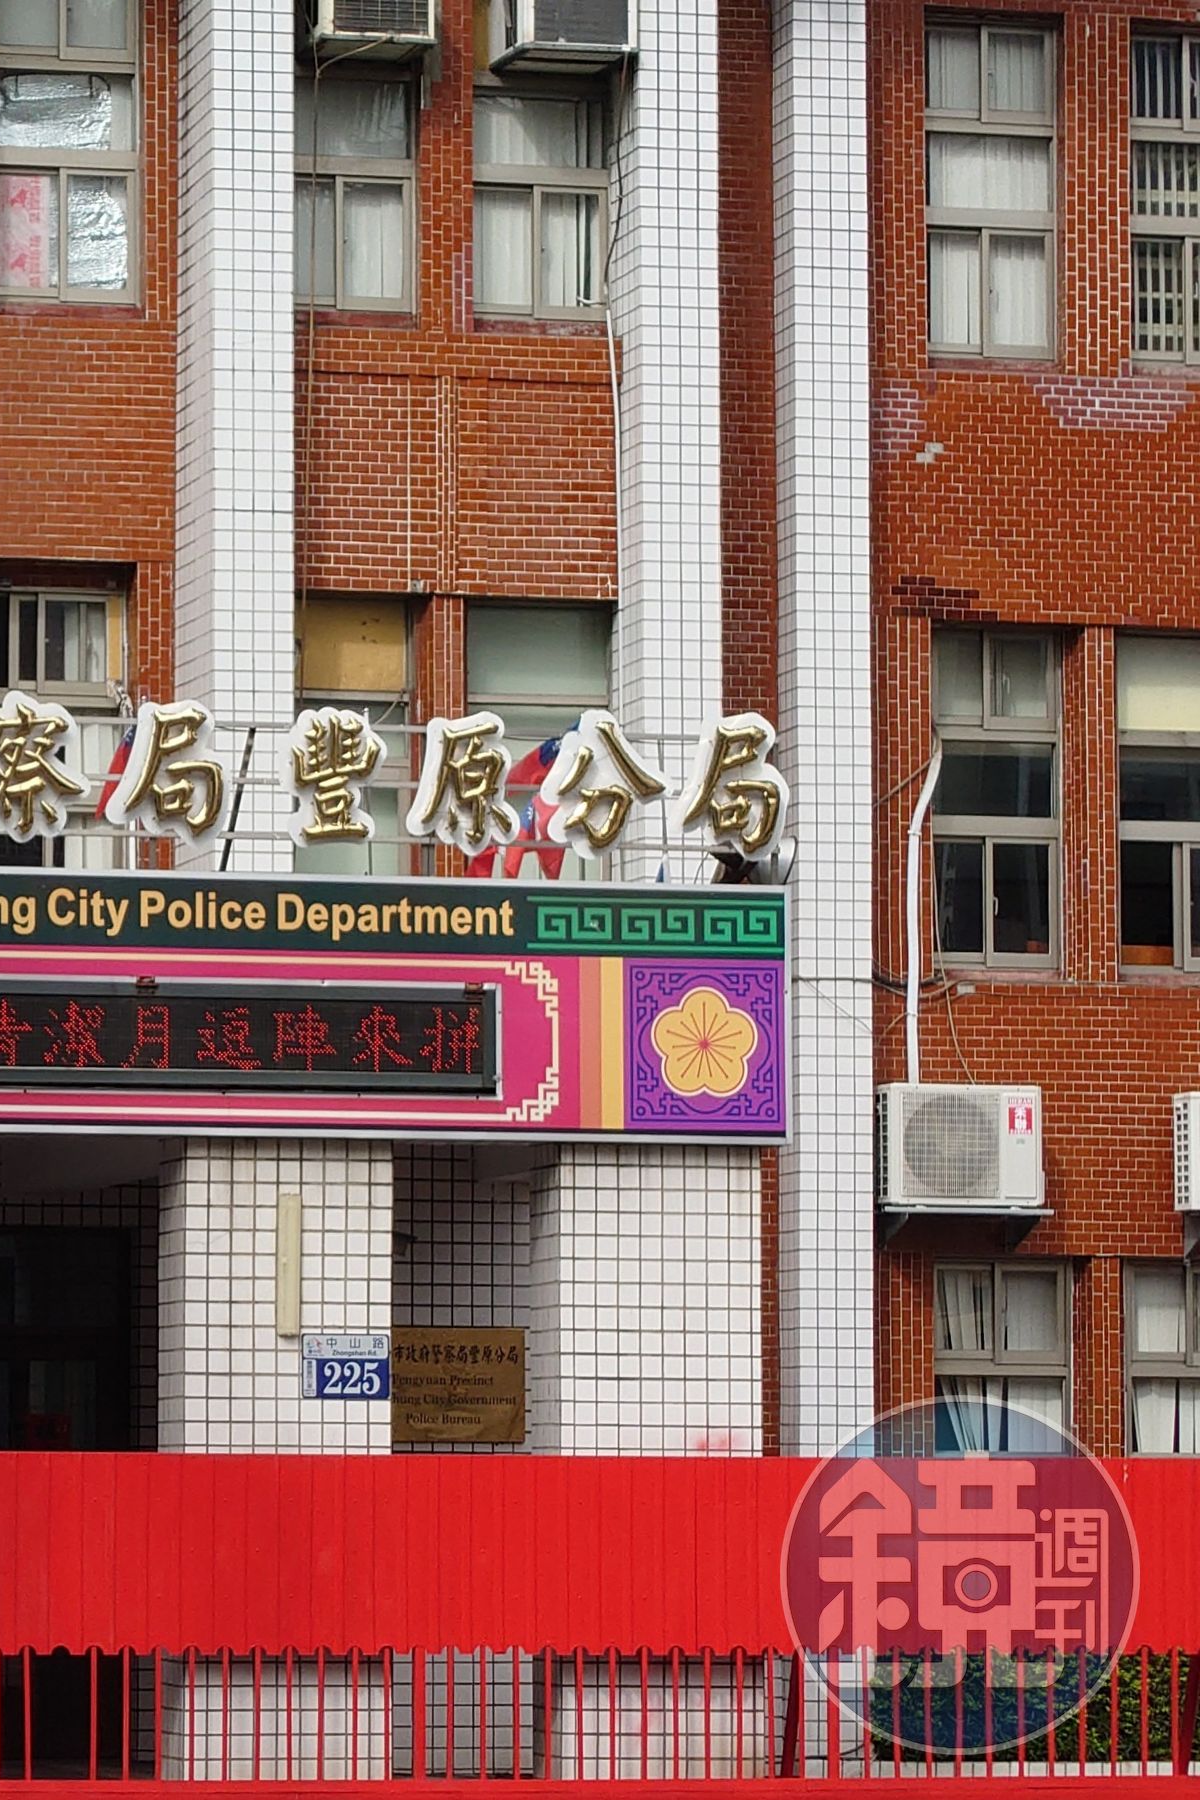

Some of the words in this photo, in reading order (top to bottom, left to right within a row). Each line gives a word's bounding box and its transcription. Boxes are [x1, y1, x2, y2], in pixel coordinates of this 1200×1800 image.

[47, 887, 129, 937] City
[140, 890, 266, 931] Police
[277, 893, 514, 942] Department
[326, 1336, 385, 1349] 中山路
[323, 1361, 381, 1395] 225
[449, 1373, 494, 1386] Precinct
[423, 1393, 449, 1408] City
[448, 1393, 517, 1406] Government
[406, 1412, 440, 1425] Police
[441, 1413, 482, 1425] Bureau
